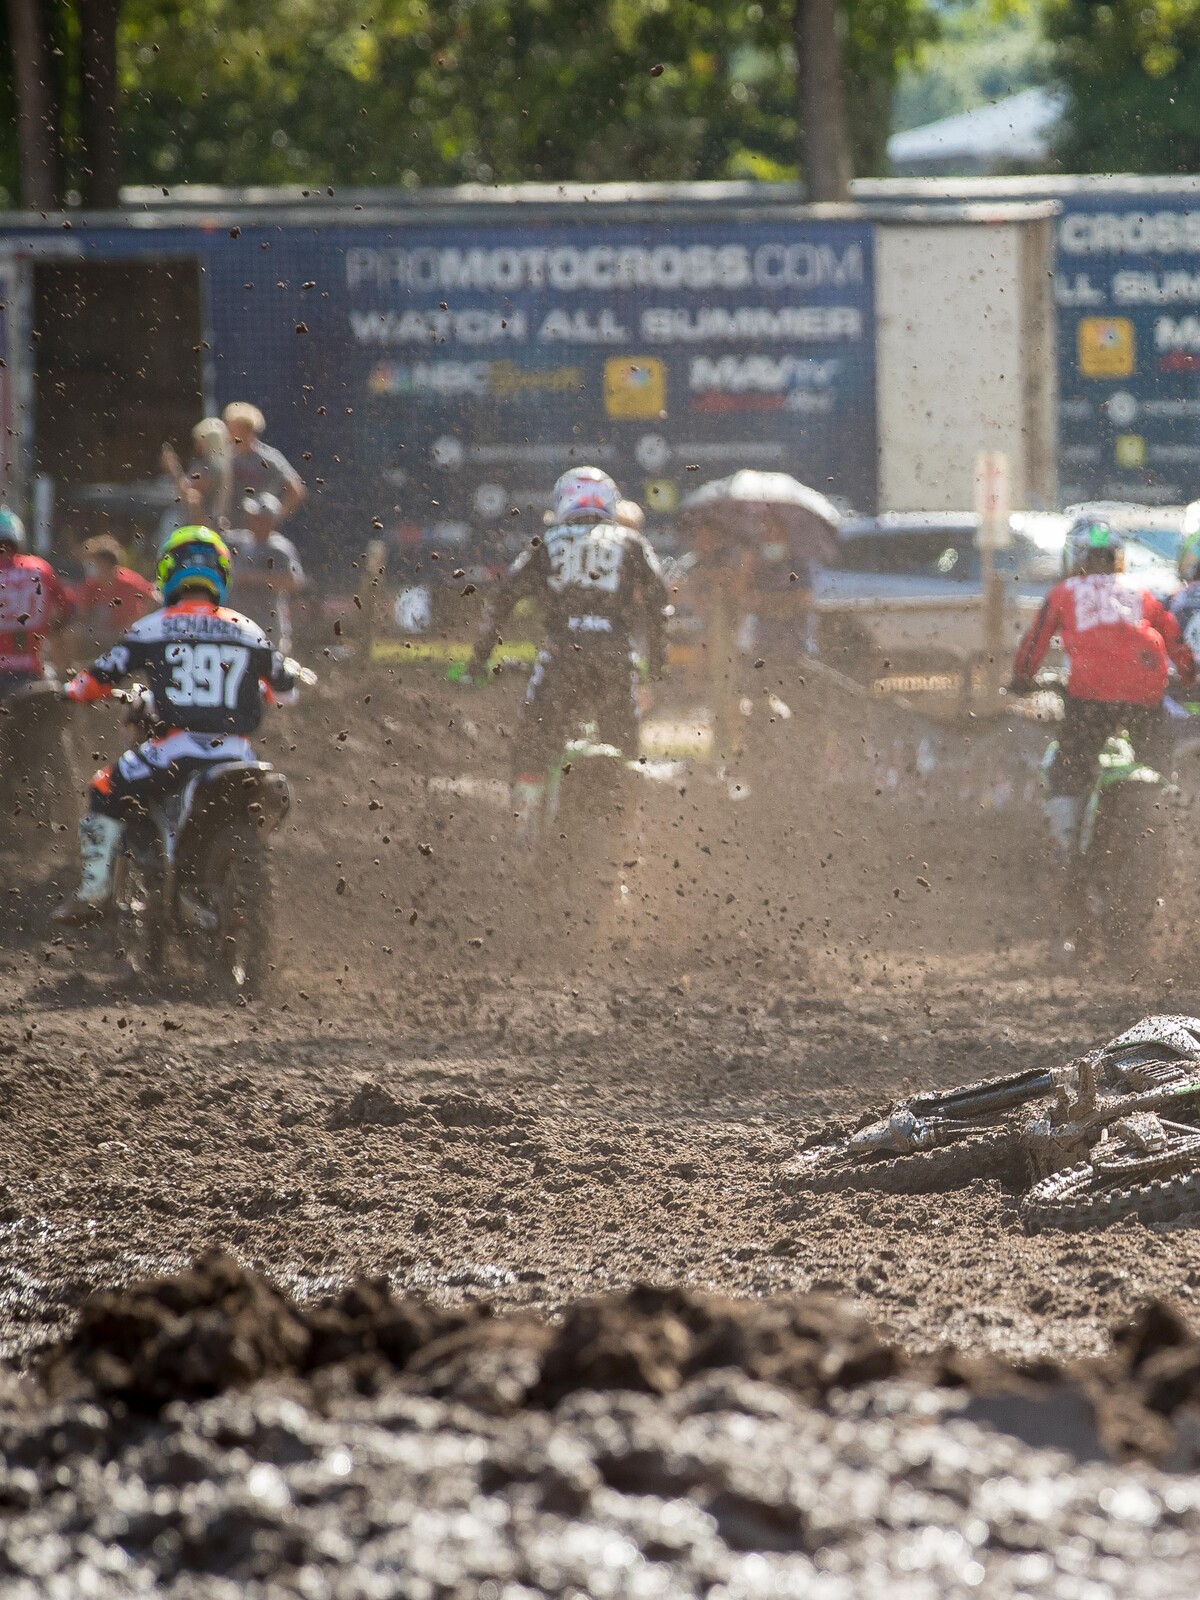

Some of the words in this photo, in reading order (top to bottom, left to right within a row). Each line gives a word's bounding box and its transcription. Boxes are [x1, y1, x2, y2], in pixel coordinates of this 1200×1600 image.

[345, 243, 863, 292] PROMOTOCROSS.COM
[348, 308, 528, 344] WATCH
[538, 308, 630, 344] ALL
[640, 306, 863, 343] SUMMER
[164, 643, 250, 710] 397
